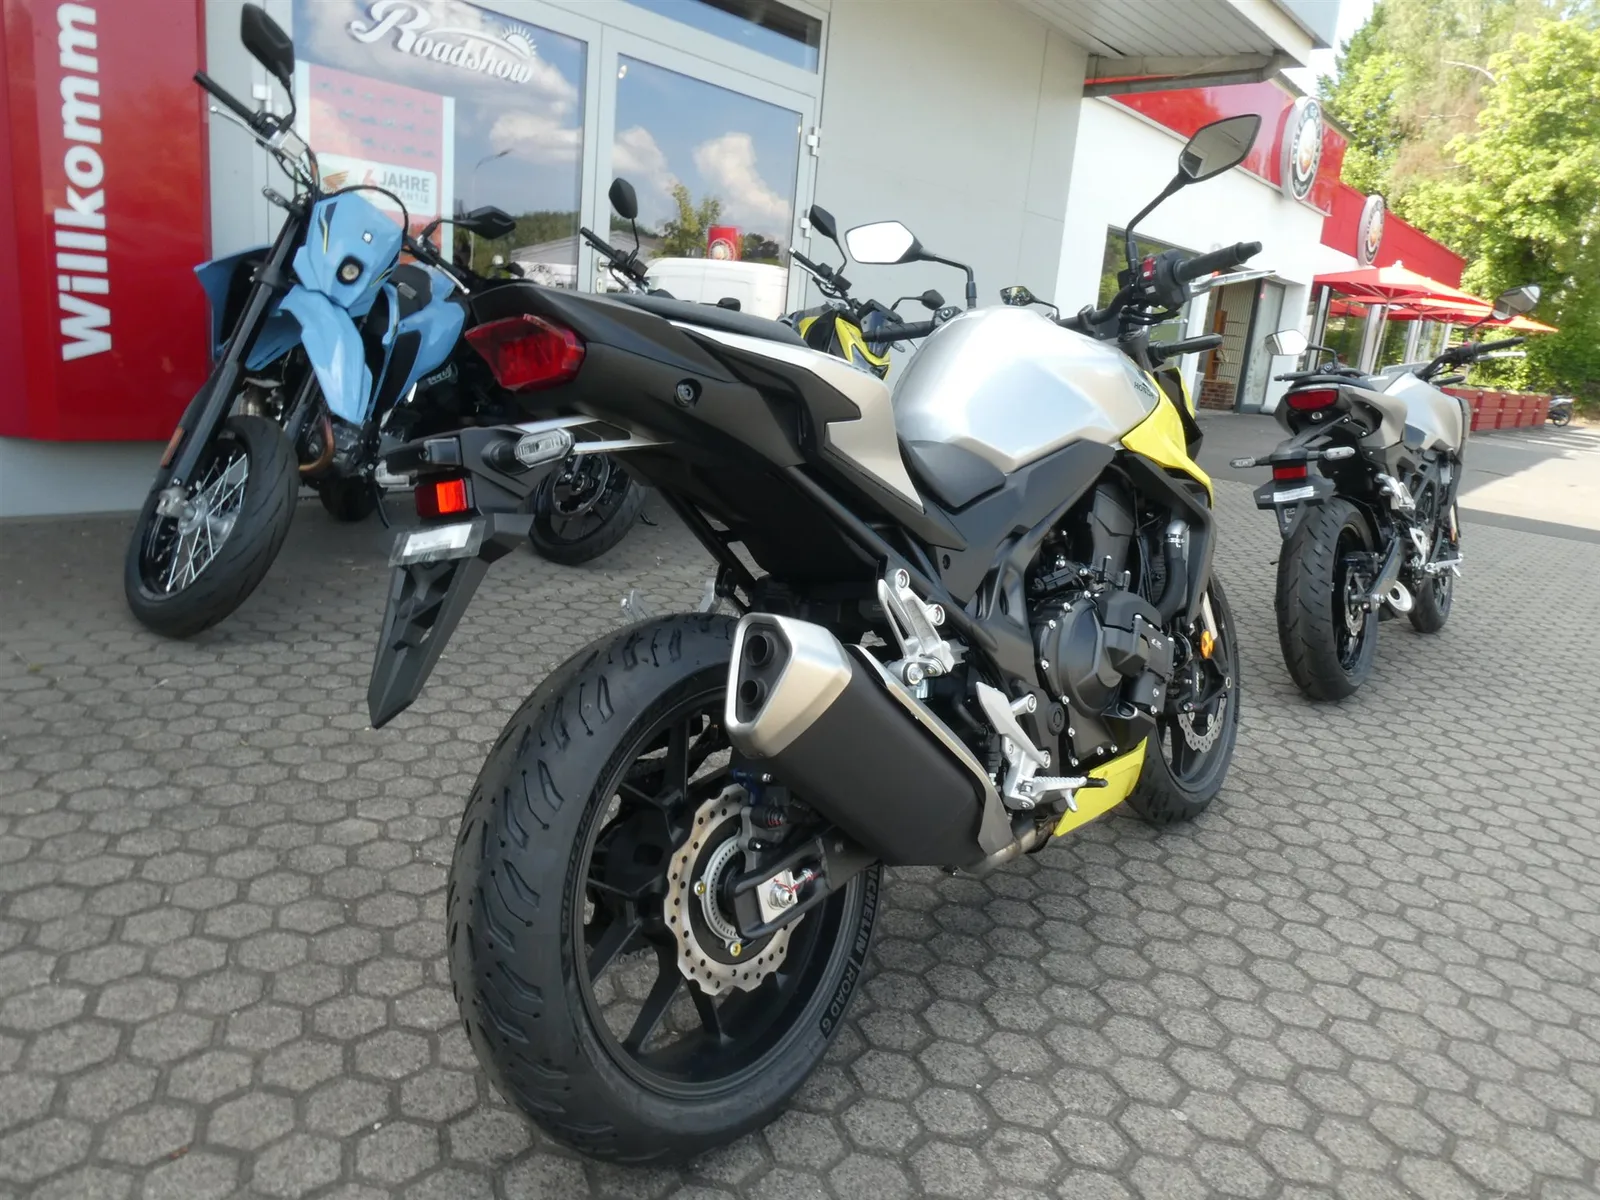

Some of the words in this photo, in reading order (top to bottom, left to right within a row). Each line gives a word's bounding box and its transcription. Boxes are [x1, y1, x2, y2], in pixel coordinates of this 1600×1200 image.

[351, 0, 533, 84] Roadshow
[54, 2, 112, 361] Willkomm
[362, 169, 377, 194] 6
[380, 171, 430, 192] JAHRE
[830, 968, 855, 1017] ROAD
